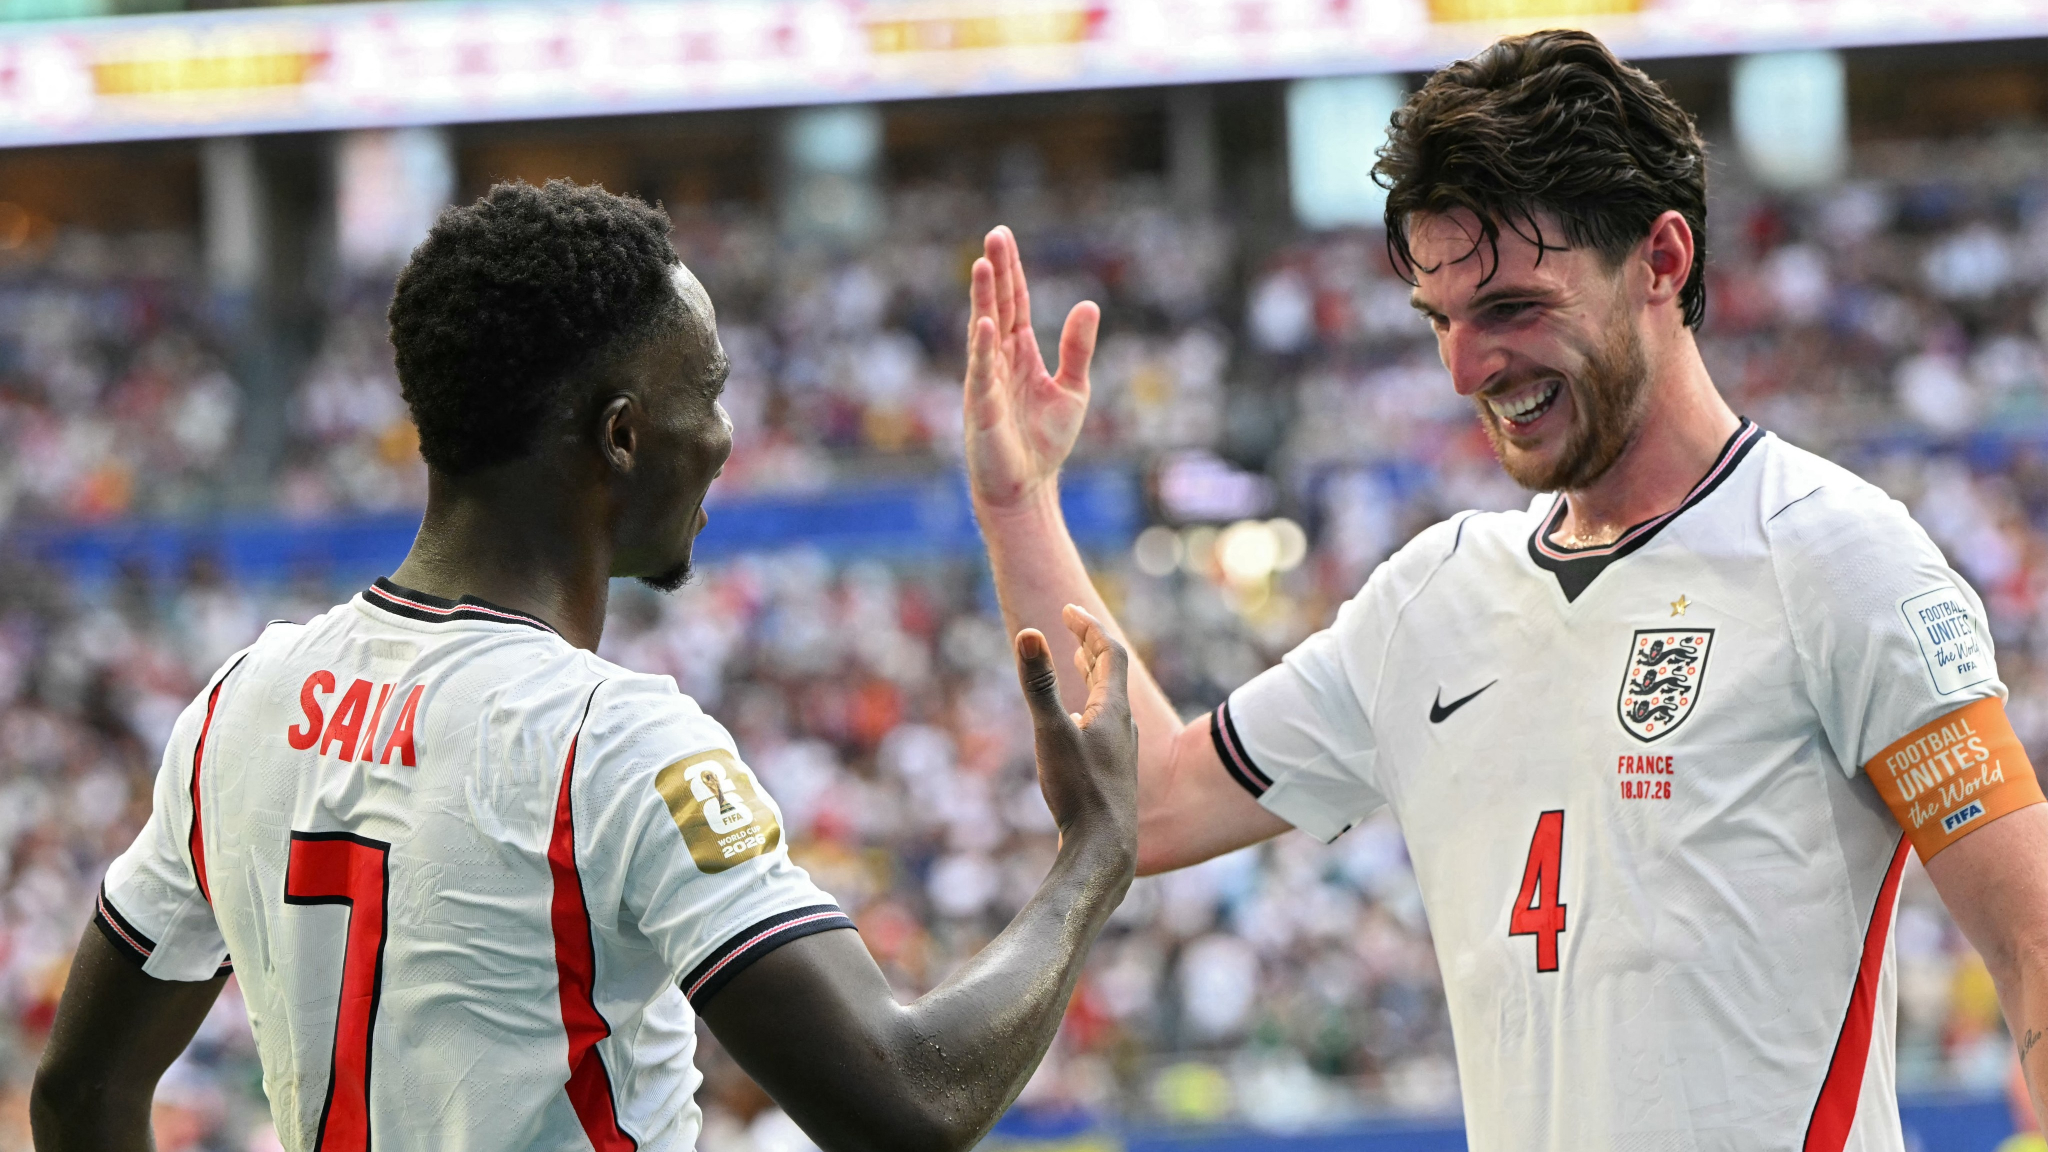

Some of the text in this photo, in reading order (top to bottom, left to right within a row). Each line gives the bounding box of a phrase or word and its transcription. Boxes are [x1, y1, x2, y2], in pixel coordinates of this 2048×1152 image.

[1927, 614, 1972, 646] UNITES
[1934, 647, 1956, 667] the
[1958, 661, 1977, 674] FIFA
[1886, 718, 1976, 777] FOOTBALL
[1617, 756, 1674, 774] FRANCE
[1896, 737, 1990, 802] UNITES
[1620, 781, 1671, 800] 18.07.26
[1908, 759, 2005, 829] the World
[722, 813, 743, 826] FIFA
[1945, 804, 1982, 830] FIFA
[717, 825, 761, 847] WORLD CUP
[722, 833, 766, 859] 2026
[1509, 809, 1567, 973] 4
[284, 830, 391, 1152] 7
